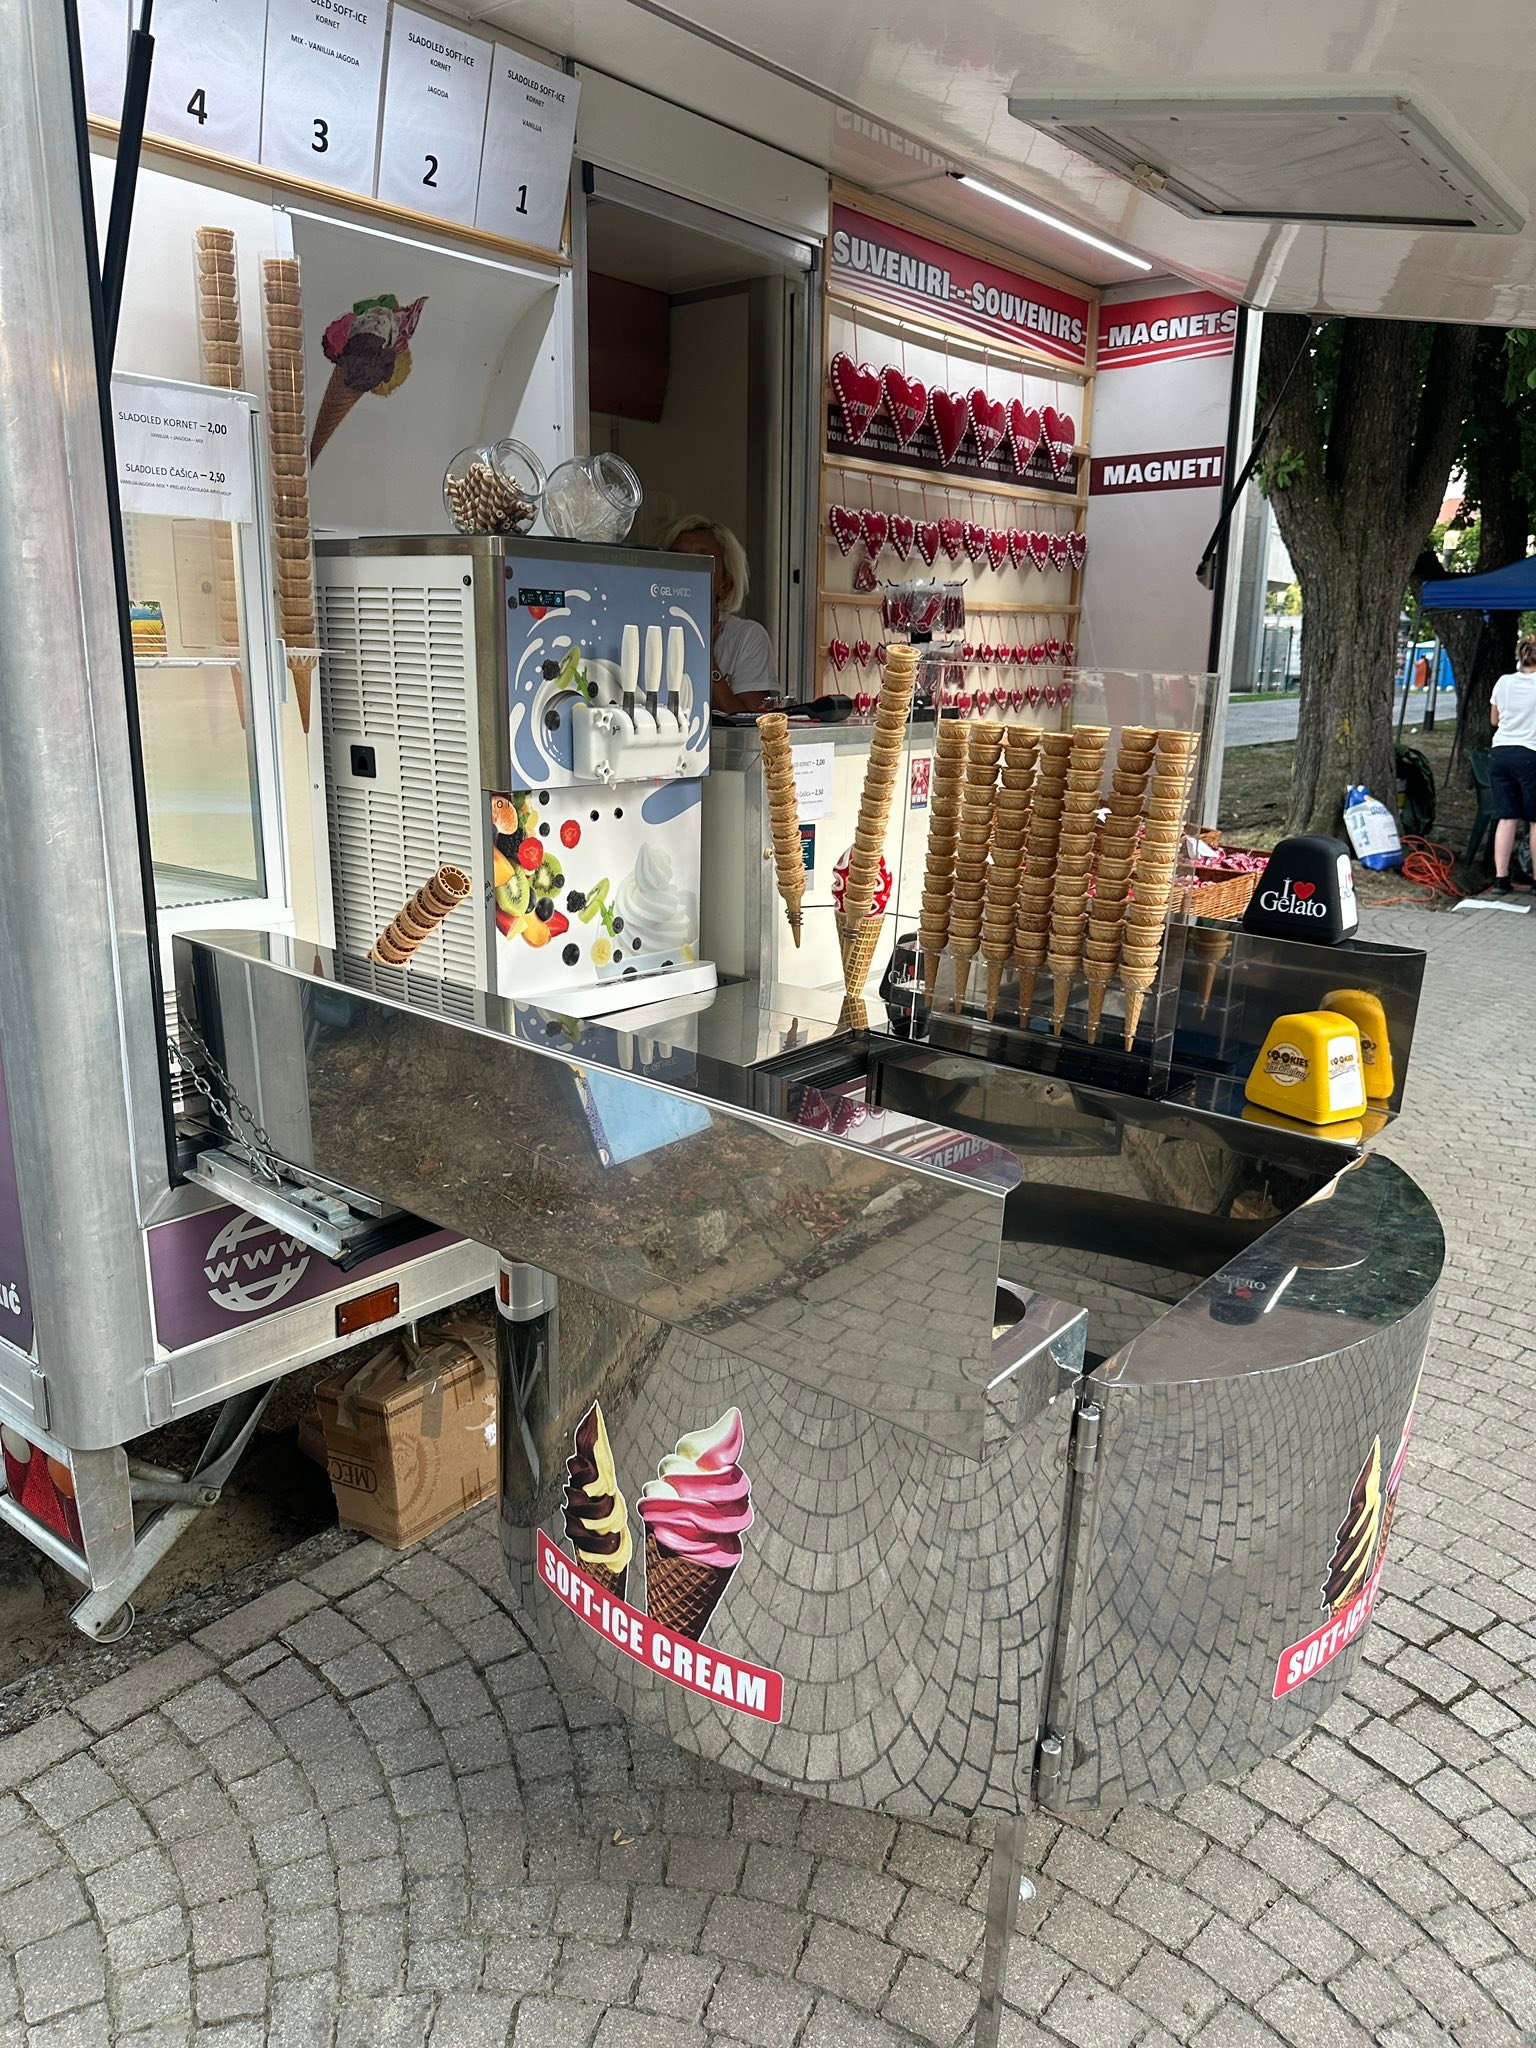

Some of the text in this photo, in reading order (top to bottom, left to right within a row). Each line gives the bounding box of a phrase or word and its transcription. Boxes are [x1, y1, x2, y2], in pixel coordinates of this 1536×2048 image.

[316, 14, 340, 29] KORNET
[333, 3, 368, 24] SOFT-ICE
[291, 34, 304, 45] MIX
[336, 52, 360, 67] JAGODA
[408, 32, 475, 67] SLADOLED SOFT-ICE
[430, 58, 451, 72] KORNET
[427, 85, 449, 99] JAGODA
[507, 69, 566, 103] SLADOLED SOFT-ICE
[186, 88, 208, 125] 4
[526, 95, 545, 108] KORNET
[311, 118, 329, 153] 3
[422, 154, 438, 188] 2
[515, 184, 528, 215] 1
[833, 230, 950, 300] SUVENIRI
[971, 281, 1083, 345] SOUVENIRS
[1108, 309, 1237, 348] MAGNETS
[118, 411, 161, 426] SLADOLED
[163, 418, 198, 430] KORNET
[207, 422, 227, 435] 2,00
[879, 440, 898, 453] YOUR
[125, 463, 167, 476] SLADOLED
[169, 466, 199, 479] ČAŠICA
[209, 471, 226, 483] 2,50
[1103, 456, 1222, 486] MAGNETI
[1280, 877, 1293, 899] I
[1260, 890, 1327, 918] Gelato
[1267, 1049, 1308, 1067] COOKIES
[543, 1546, 767, 1713] SOFT-ICE CREAM
[1286, 1588, 1368, 1685] SOFT-ICE
